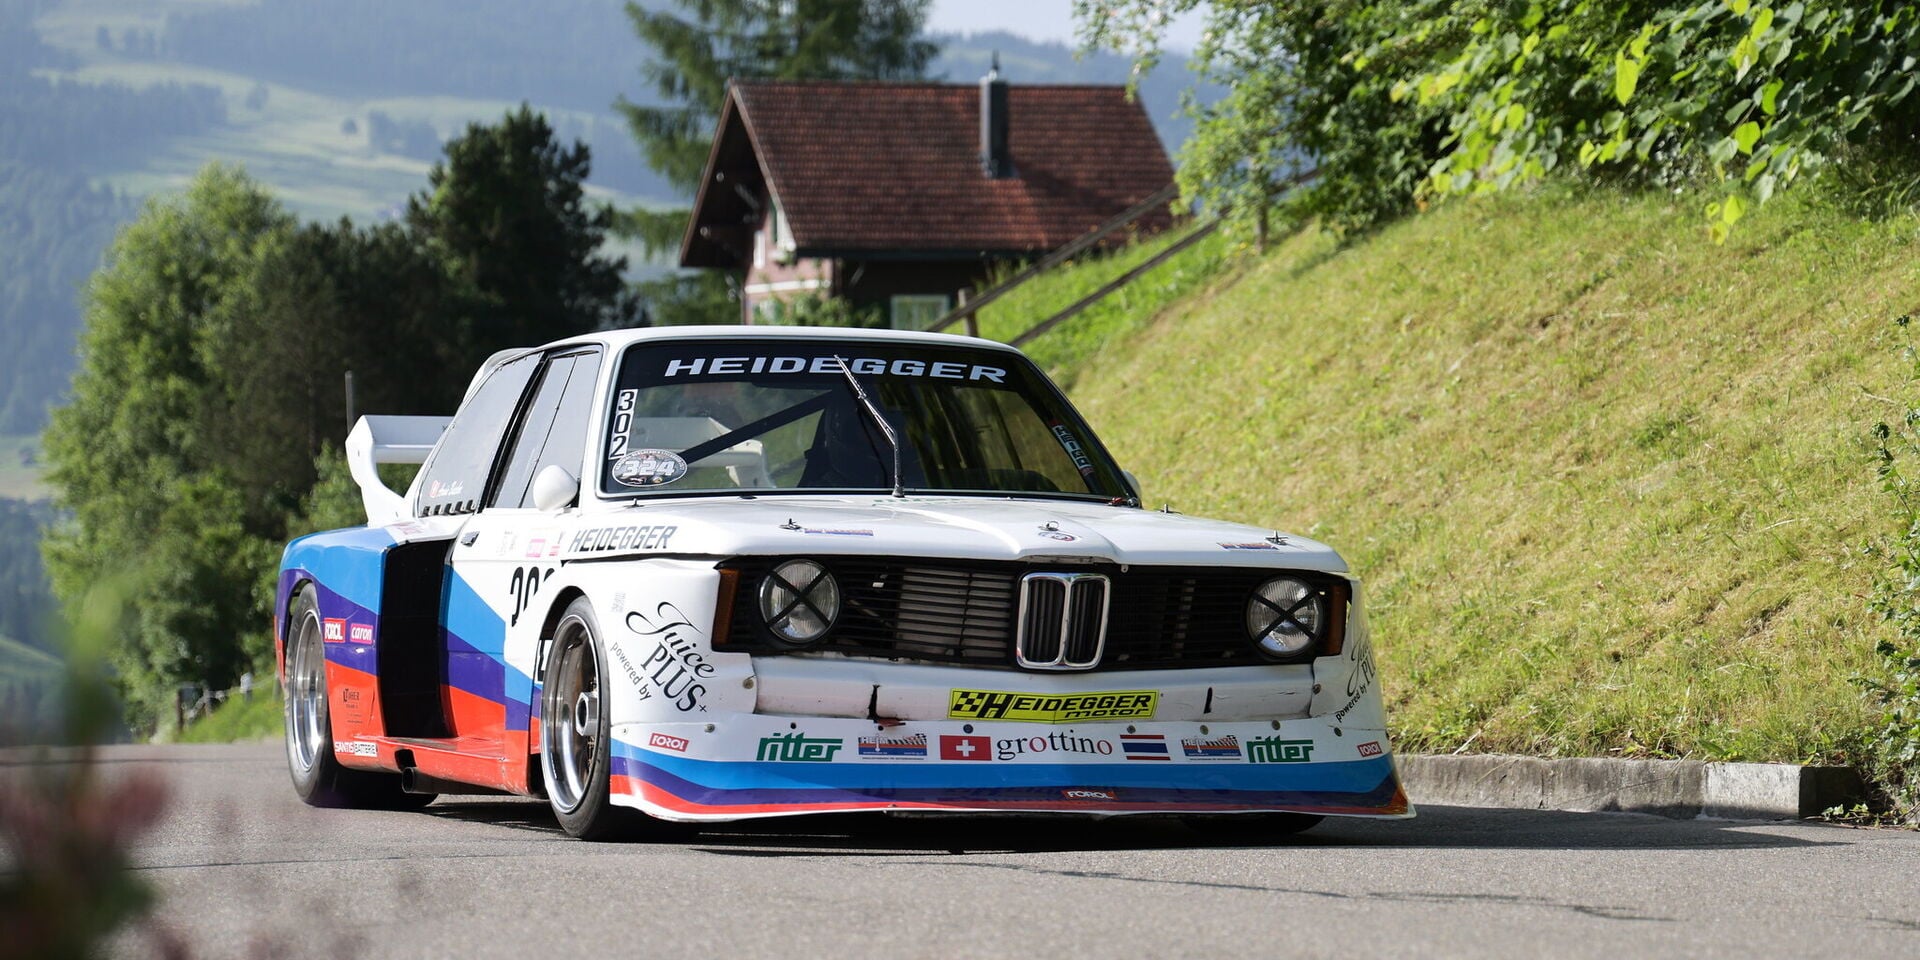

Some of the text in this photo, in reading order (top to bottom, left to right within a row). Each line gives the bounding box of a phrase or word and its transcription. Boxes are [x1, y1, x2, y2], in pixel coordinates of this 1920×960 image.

[664, 357, 1007, 383] HEIDEGGER
[610, 391, 635, 459] 302
[622, 460, 675, 476] 324
[568, 526, 678, 552] HEIDEGGER
[625, 601, 719, 678] Juice
[610, 642, 652, 701] powered by
[976, 692, 1152, 718] HEIDEGGER
[1065, 707, 1149, 717] motor
[1335, 684, 1368, 723] powered by
[756, 732, 843, 761] ritter
[997, 730, 1113, 761] grottino
[1246, 735, 1314, 763] ritter
[1067, 790, 1113, 799] FOROL
